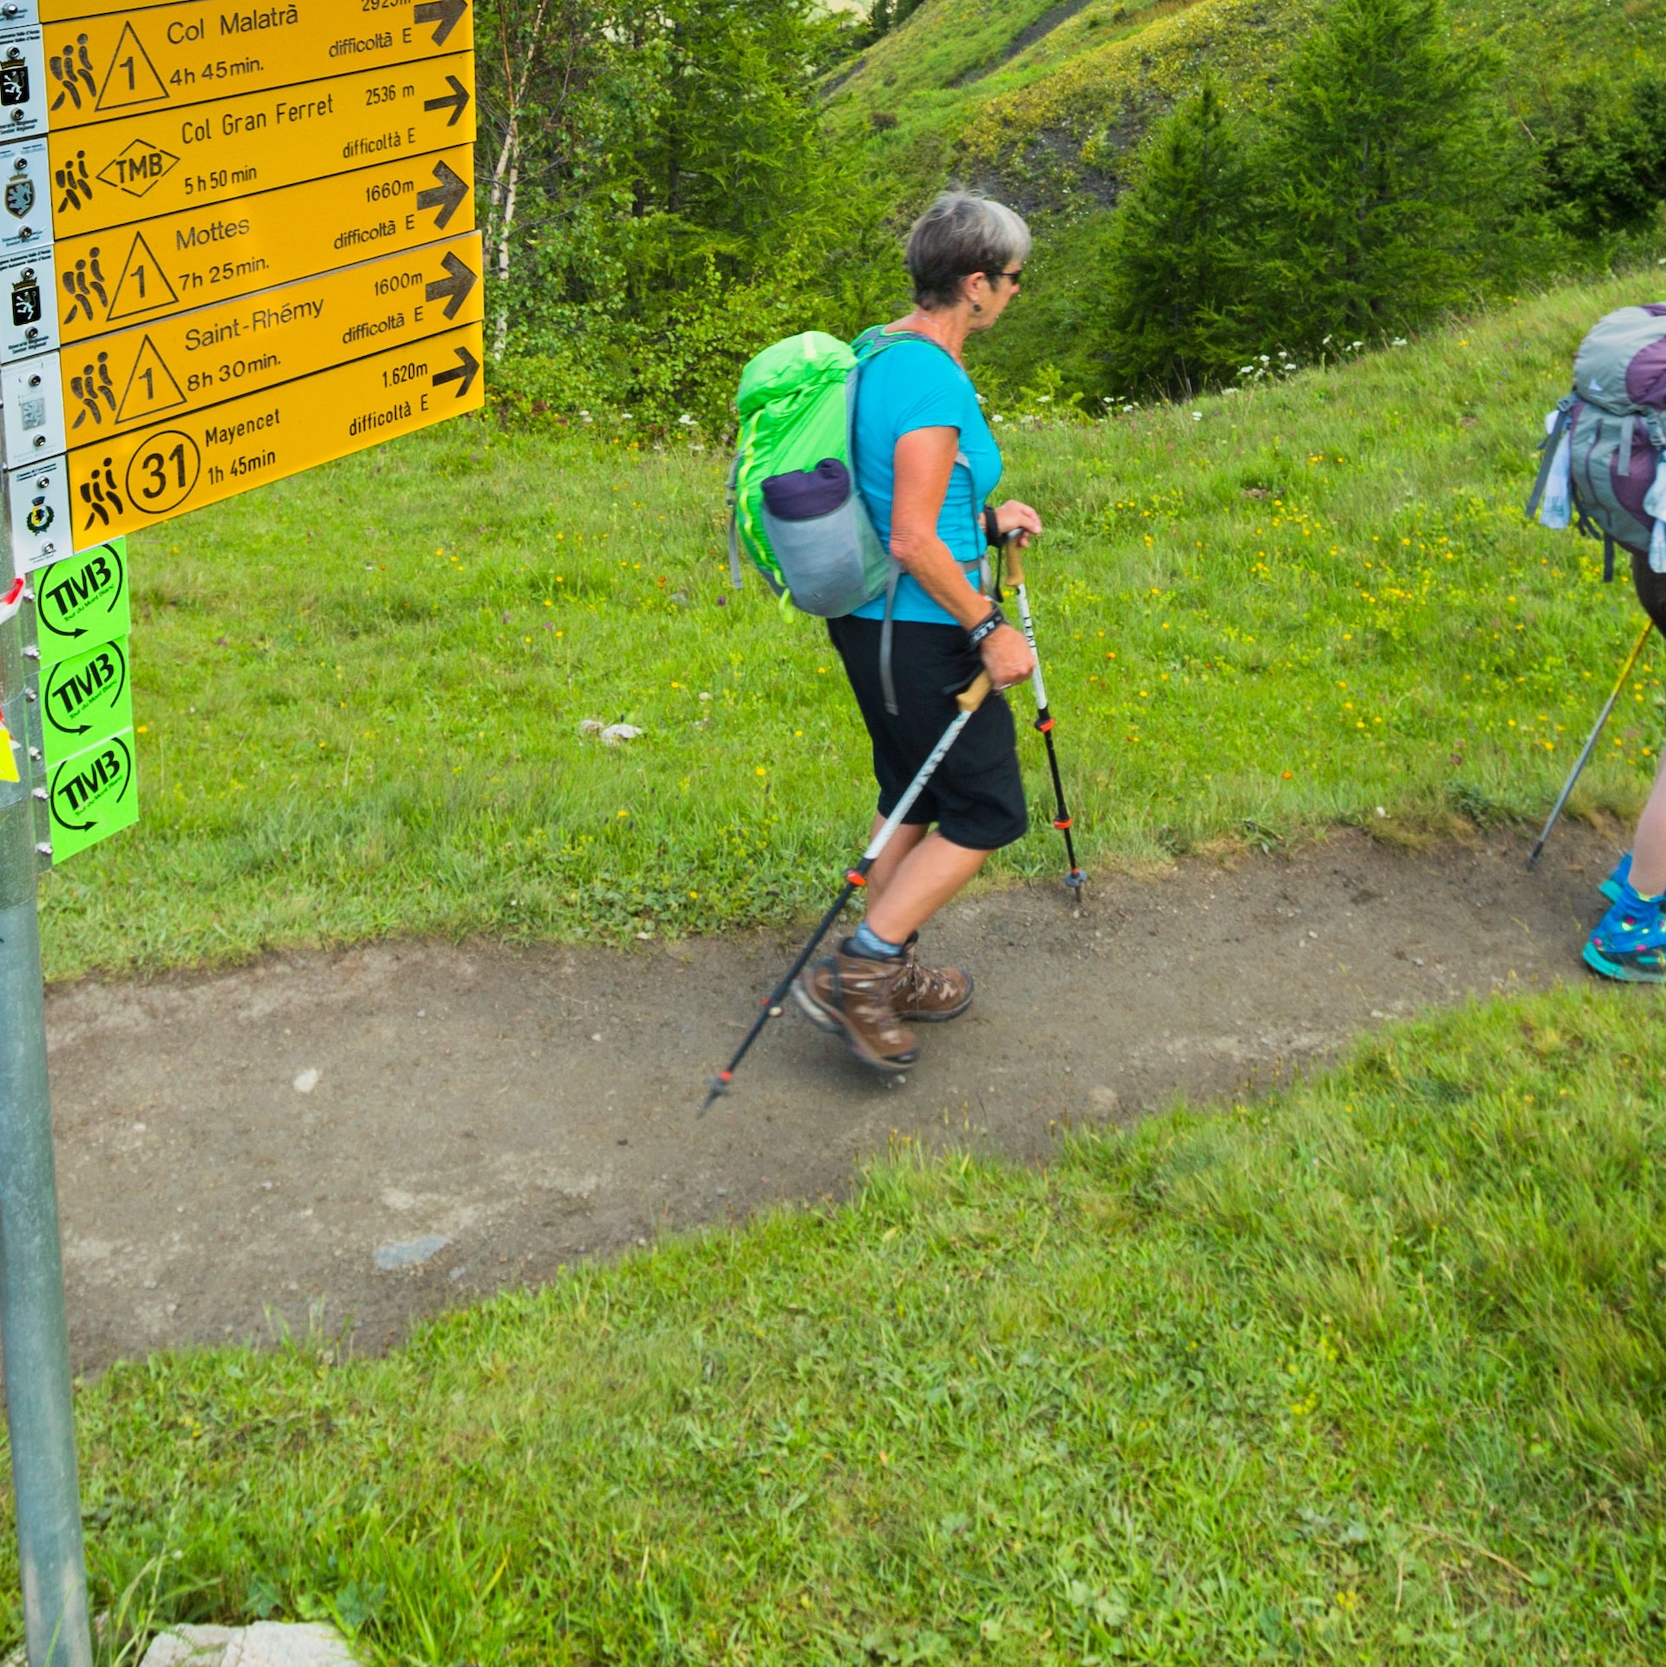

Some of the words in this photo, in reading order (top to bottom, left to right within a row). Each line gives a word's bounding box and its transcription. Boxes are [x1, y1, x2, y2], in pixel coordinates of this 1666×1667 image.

[167, 18, 204, 45] Col
[221, 3, 298, 35] Malatrà
[328, 31, 393, 58] difficoltà
[403, 27, 412, 44] E
[119, 56, 135, 91] 1
[170, 68, 196, 86] 4h
[365, 84, 396, 106] 2536
[402, 85, 415, 98] m
[182, 118, 212, 145] Col
[222, 112, 267, 136] Gran
[276, 93, 334, 124] Ferret
[342, 131, 401, 159] difficoltà
[408, 127, 416, 144] E
[115, 152, 163, 184] TMB
[366, 180, 414, 203] 1660m
[176, 218, 250, 251] Mottes
[333, 220, 396, 250] difficoltà
[406, 214, 415, 230] E
[130, 264, 146, 298] 1
[178, 272, 204, 292] 7h
[374, 272, 423, 296] 1600m
[342, 313, 405, 344] difficoltà
[414, 306, 424, 322] E
[138, 367, 154, 400] 1
[187, 372, 214, 392] 8h
[382, 362, 428, 388] 1.620m
[205, 408, 281, 447] Mayencet
[349, 401, 412, 436] difficoltà
[421, 393, 429, 411] E
[142, 443, 186, 499] 31
[208, 466, 224, 485] 1h
[45, 556, 111, 615] TMB
[52, 653, 114, 713] TMB
[57, 750, 120, 811] TMB
